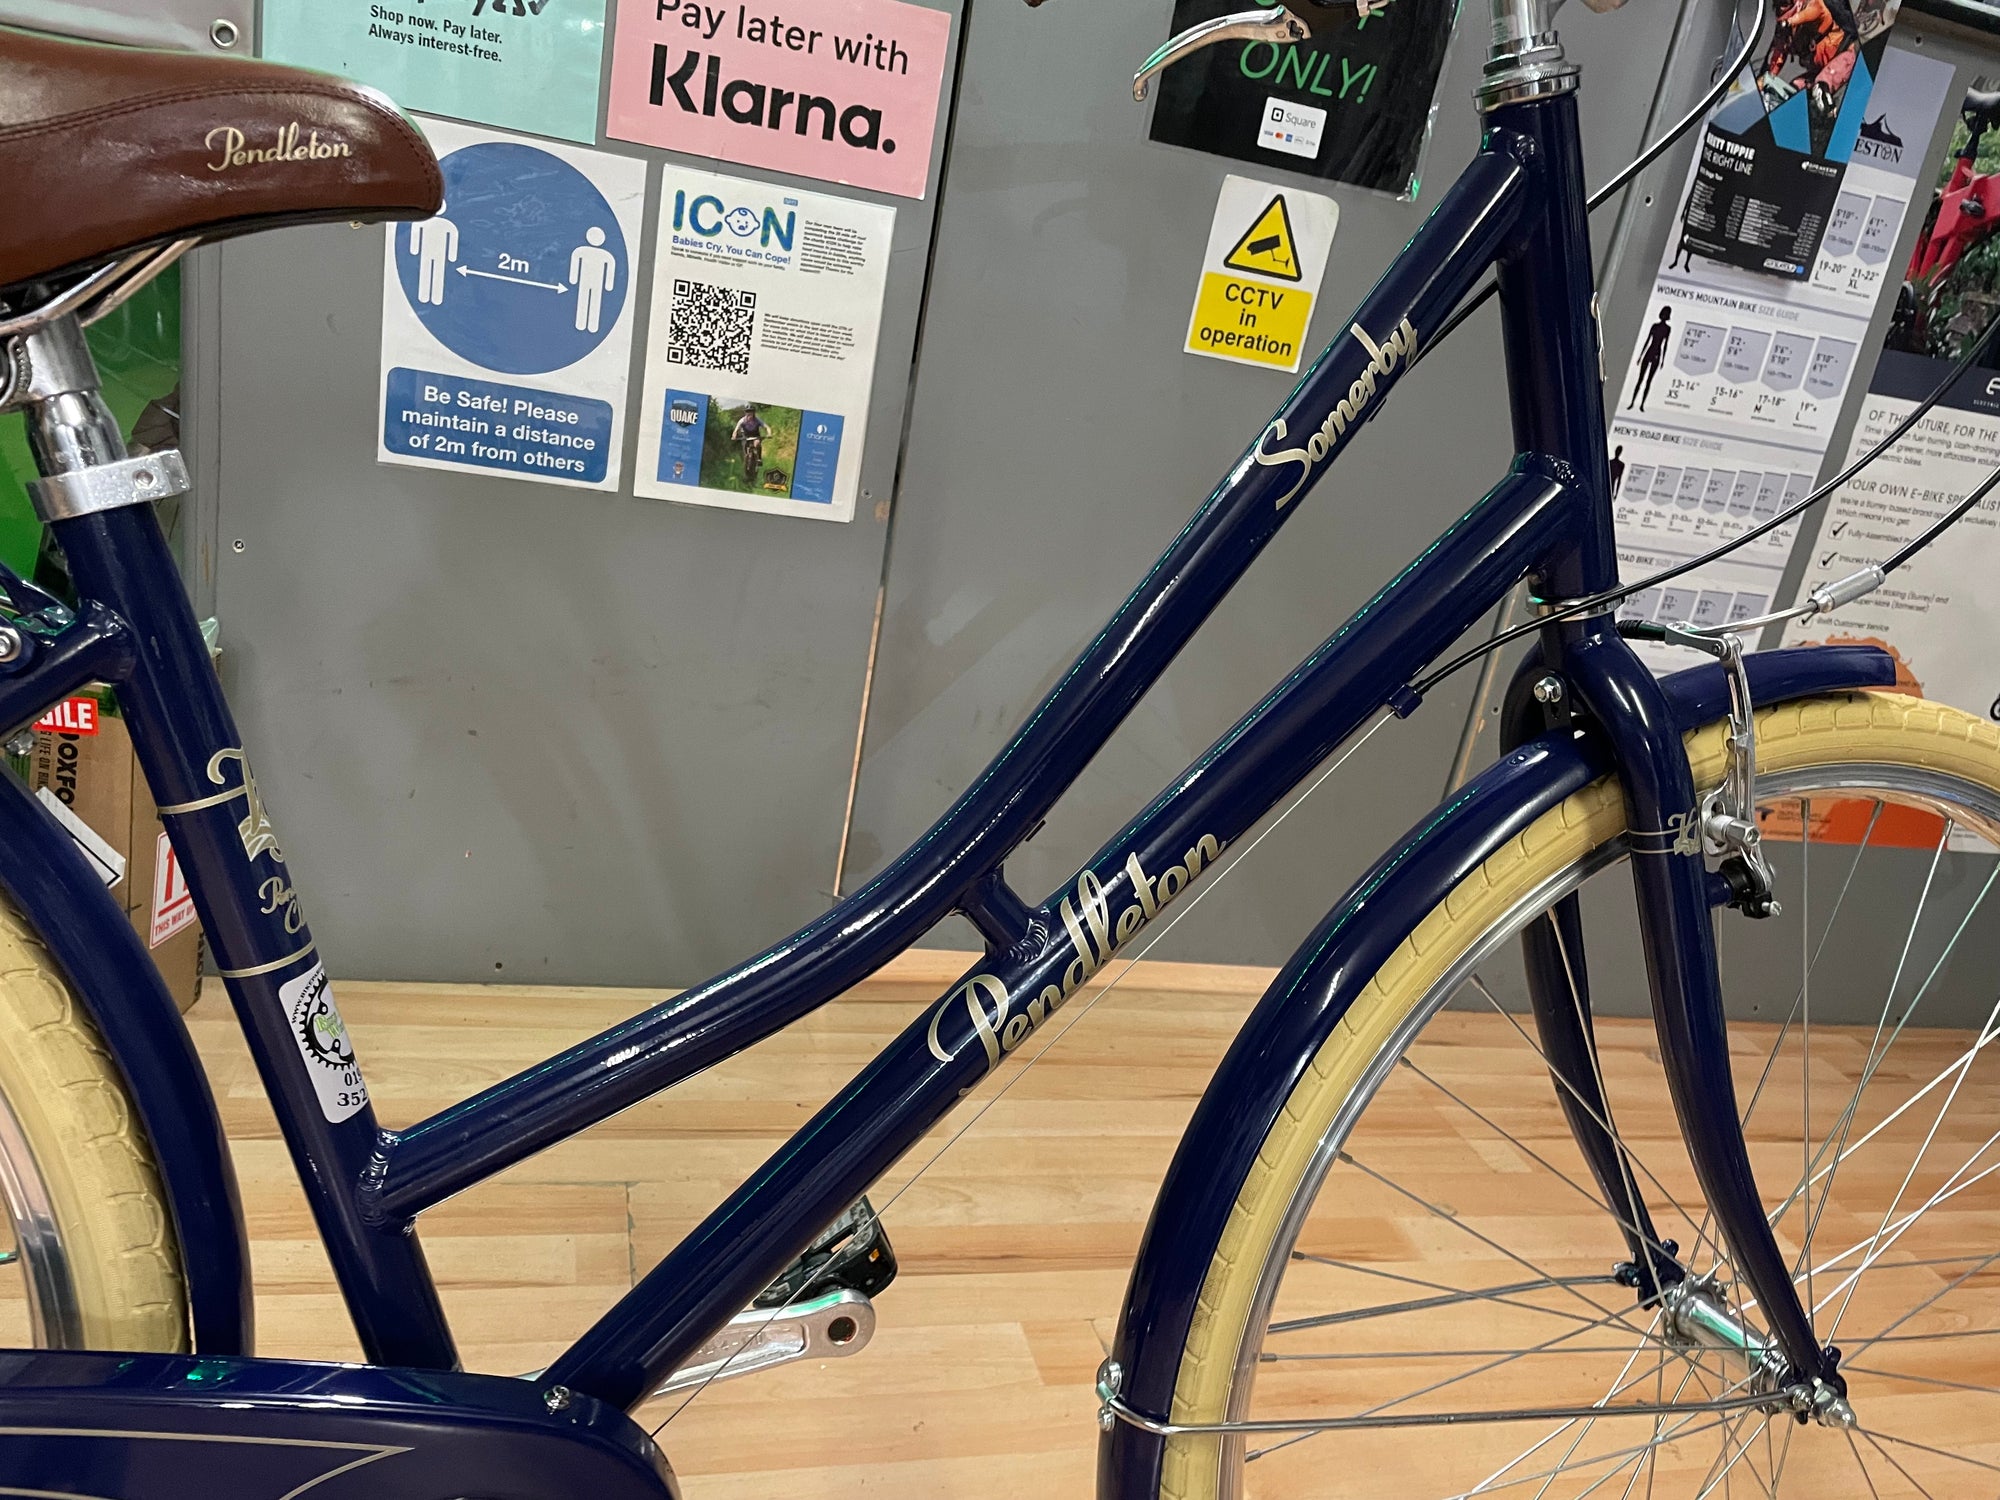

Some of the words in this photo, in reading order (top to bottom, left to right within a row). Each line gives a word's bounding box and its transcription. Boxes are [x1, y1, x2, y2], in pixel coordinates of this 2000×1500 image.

[370, 5, 404, 24] Shop
[408, 15, 438, 31] now.
[443, 19, 466, 38] Pay
[470, 25, 503, 44] later.
[368, 23, 414, 45] Always
[418, 33, 503, 63] interest-free.
[737, 5, 823, 54] later
[834, 33, 909, 75] with
[1240, 40, 1377, 104] ONLY!
[649, 43, 896, 154] Klarna.
[1285, 112, 1317, 129] Square
[205, 121, 351, 172] Pendleton
[1726, 141, 1756, 161] TIPPIE
[1734, 159, 1754, 176] LINE
[498, 253, 530, 273] 2m
[672, 235, 704, 249] Babies
[725, 245, 743, 257] You
[745, 249, 763, 260] Can
[764, 252, 791, 266] Cope!
[1225, 283, 1284, 310] CCTV
[1657, 284, 1694, 300] WOMEN'S
[1696, 291, 1738, 309] MOUNTAIN
[1738, 301, 1758, 313] BIKE
[1239, 308, 1257, 328] in
[1200, 326, 1292, 356] operation
[424, 385, 451, 405] Be
[457, 390, 508, 414] Safe!
[513, 400, 580, 425] Please
[1666, 389, 1679, 400] XS
[1710, 397, 1717, 406] S
[671, 408, 699, 425] QUAKE
[1255, 318, 1418, 511] Somerby
[1869, 409, 1886, 422] OF
[1917, 416, 1950, 435] UTURE,
[1953, 424, 1975, 438] FOR
[1978, 428, 1999, 443] THE
[402, 409, 489, 435] maintain
[494, 423, 507, 437] a
[512, 424, 596, 451] distance
[1639, 430, 1662, 442] ROAD
[1662, 433, 1681, 445] BIKE
[409, 434, 430, 449] of
[434, 436, 465, 454] 2m
[472, 441, 517, 463] from
[523, 452, 585, 473] others
[1879, 483, 1909, 498] OWN
[1910, 488, 1945, 505] E-BIKE
[927, 833, 1227, 1096] Pendleton
